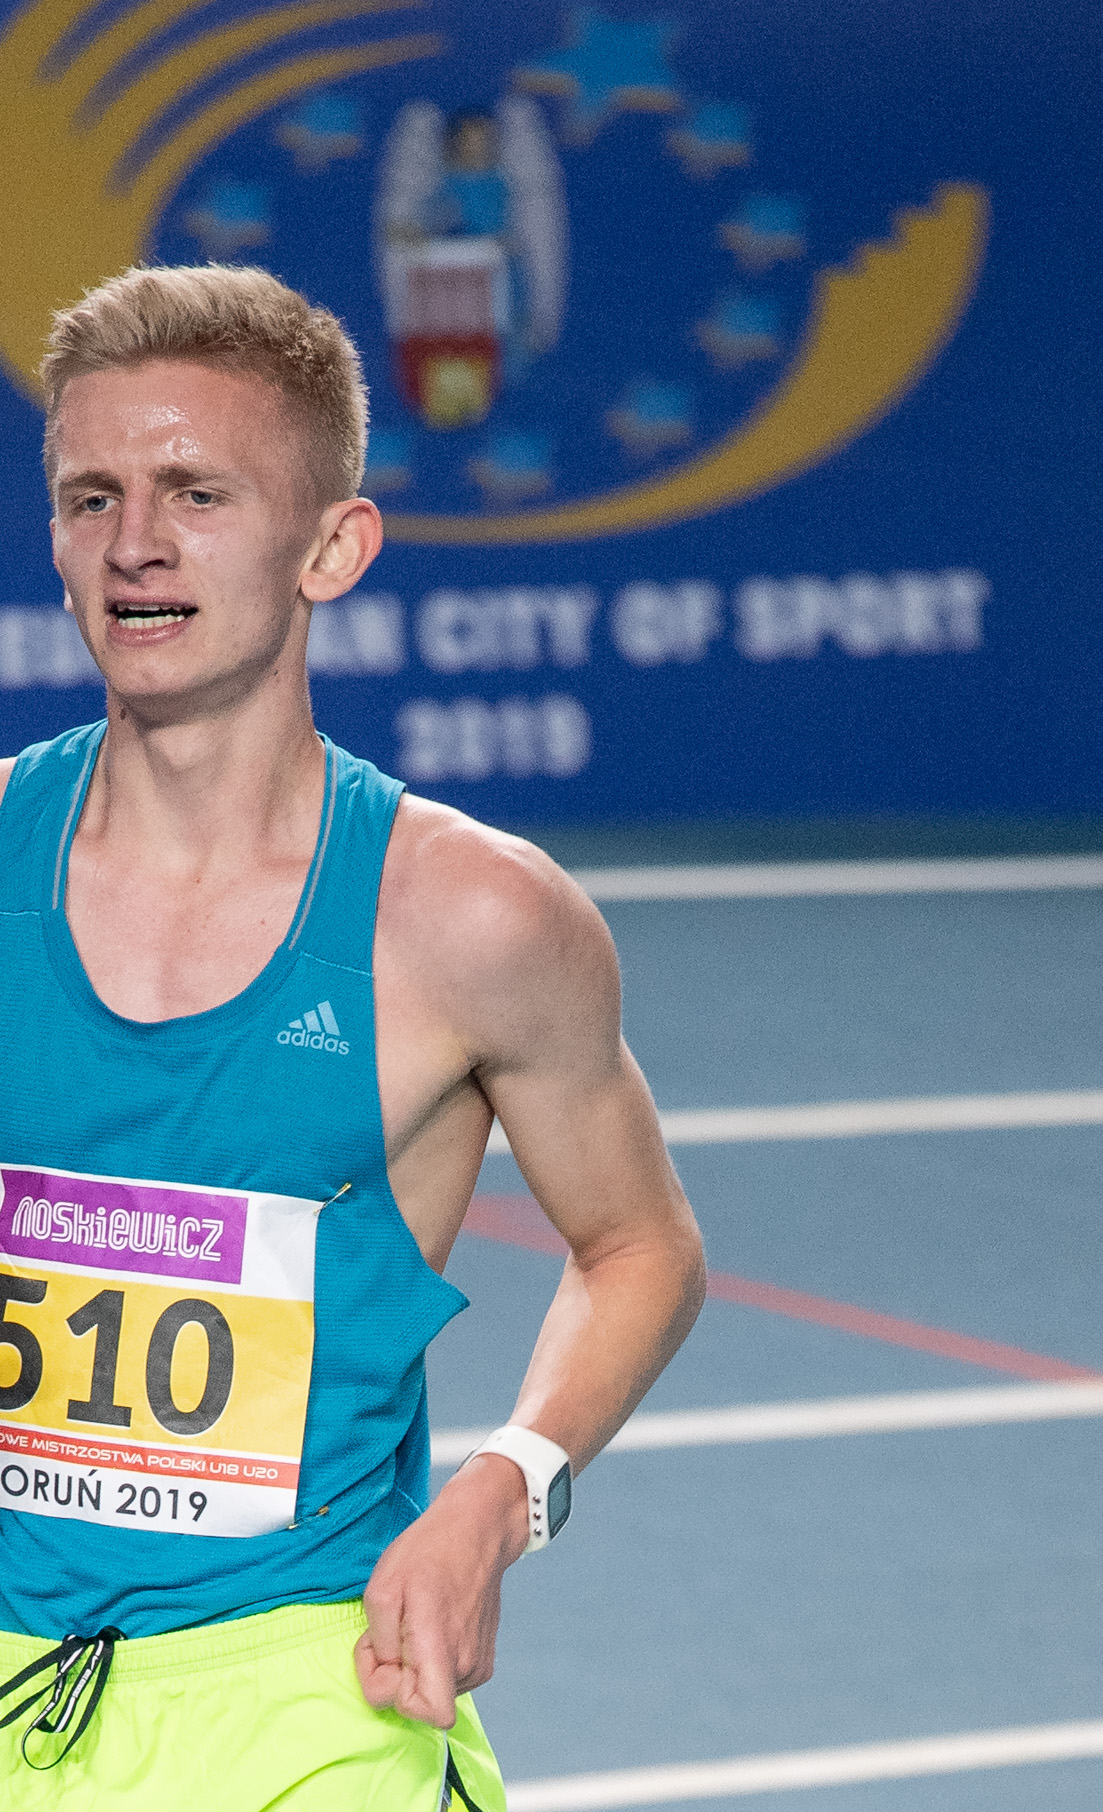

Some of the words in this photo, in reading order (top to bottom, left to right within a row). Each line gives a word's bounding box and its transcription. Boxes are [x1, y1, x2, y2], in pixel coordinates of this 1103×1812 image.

[418, 587, 596, 672] CITY
[612, 580, 722, 665] OF
[734, 571, 989, 661] SPORT
[277, 1029, 350, 1055] adidas
[31, 1438, 145, 1466] MISTRZOSTWA
[147, 1455, 206, 1473] POLSKI
[209, 1462, 240, 1476] U18
[243, 1466, 279, 1480] U20
[115, 1483, 208, 1522] 2019
